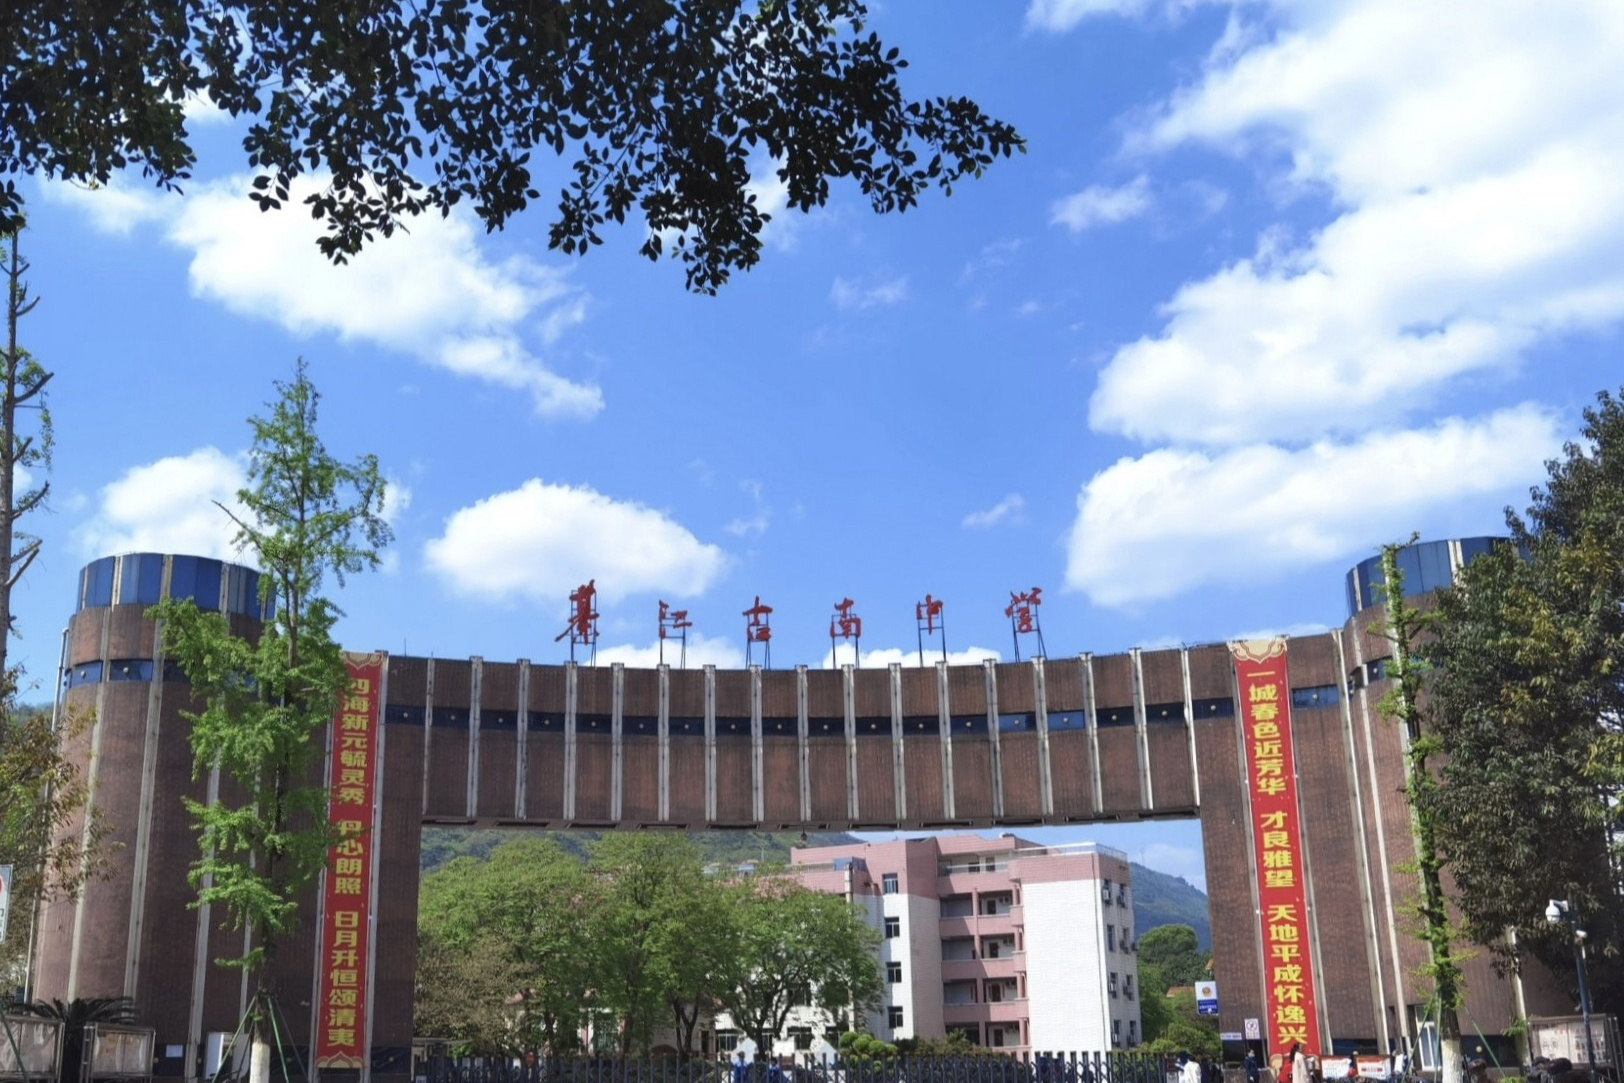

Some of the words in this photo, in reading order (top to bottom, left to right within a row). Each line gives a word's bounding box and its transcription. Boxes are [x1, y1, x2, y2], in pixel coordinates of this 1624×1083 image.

[1247, 671, 1286, 795] 一城春色近芳华
[335, 820, 363, 894] 丹心朗照
[1260, 810, 1295, 888] 才良雅望
[1267, 904, 1307, 1045] 天地平成怀逸兴
